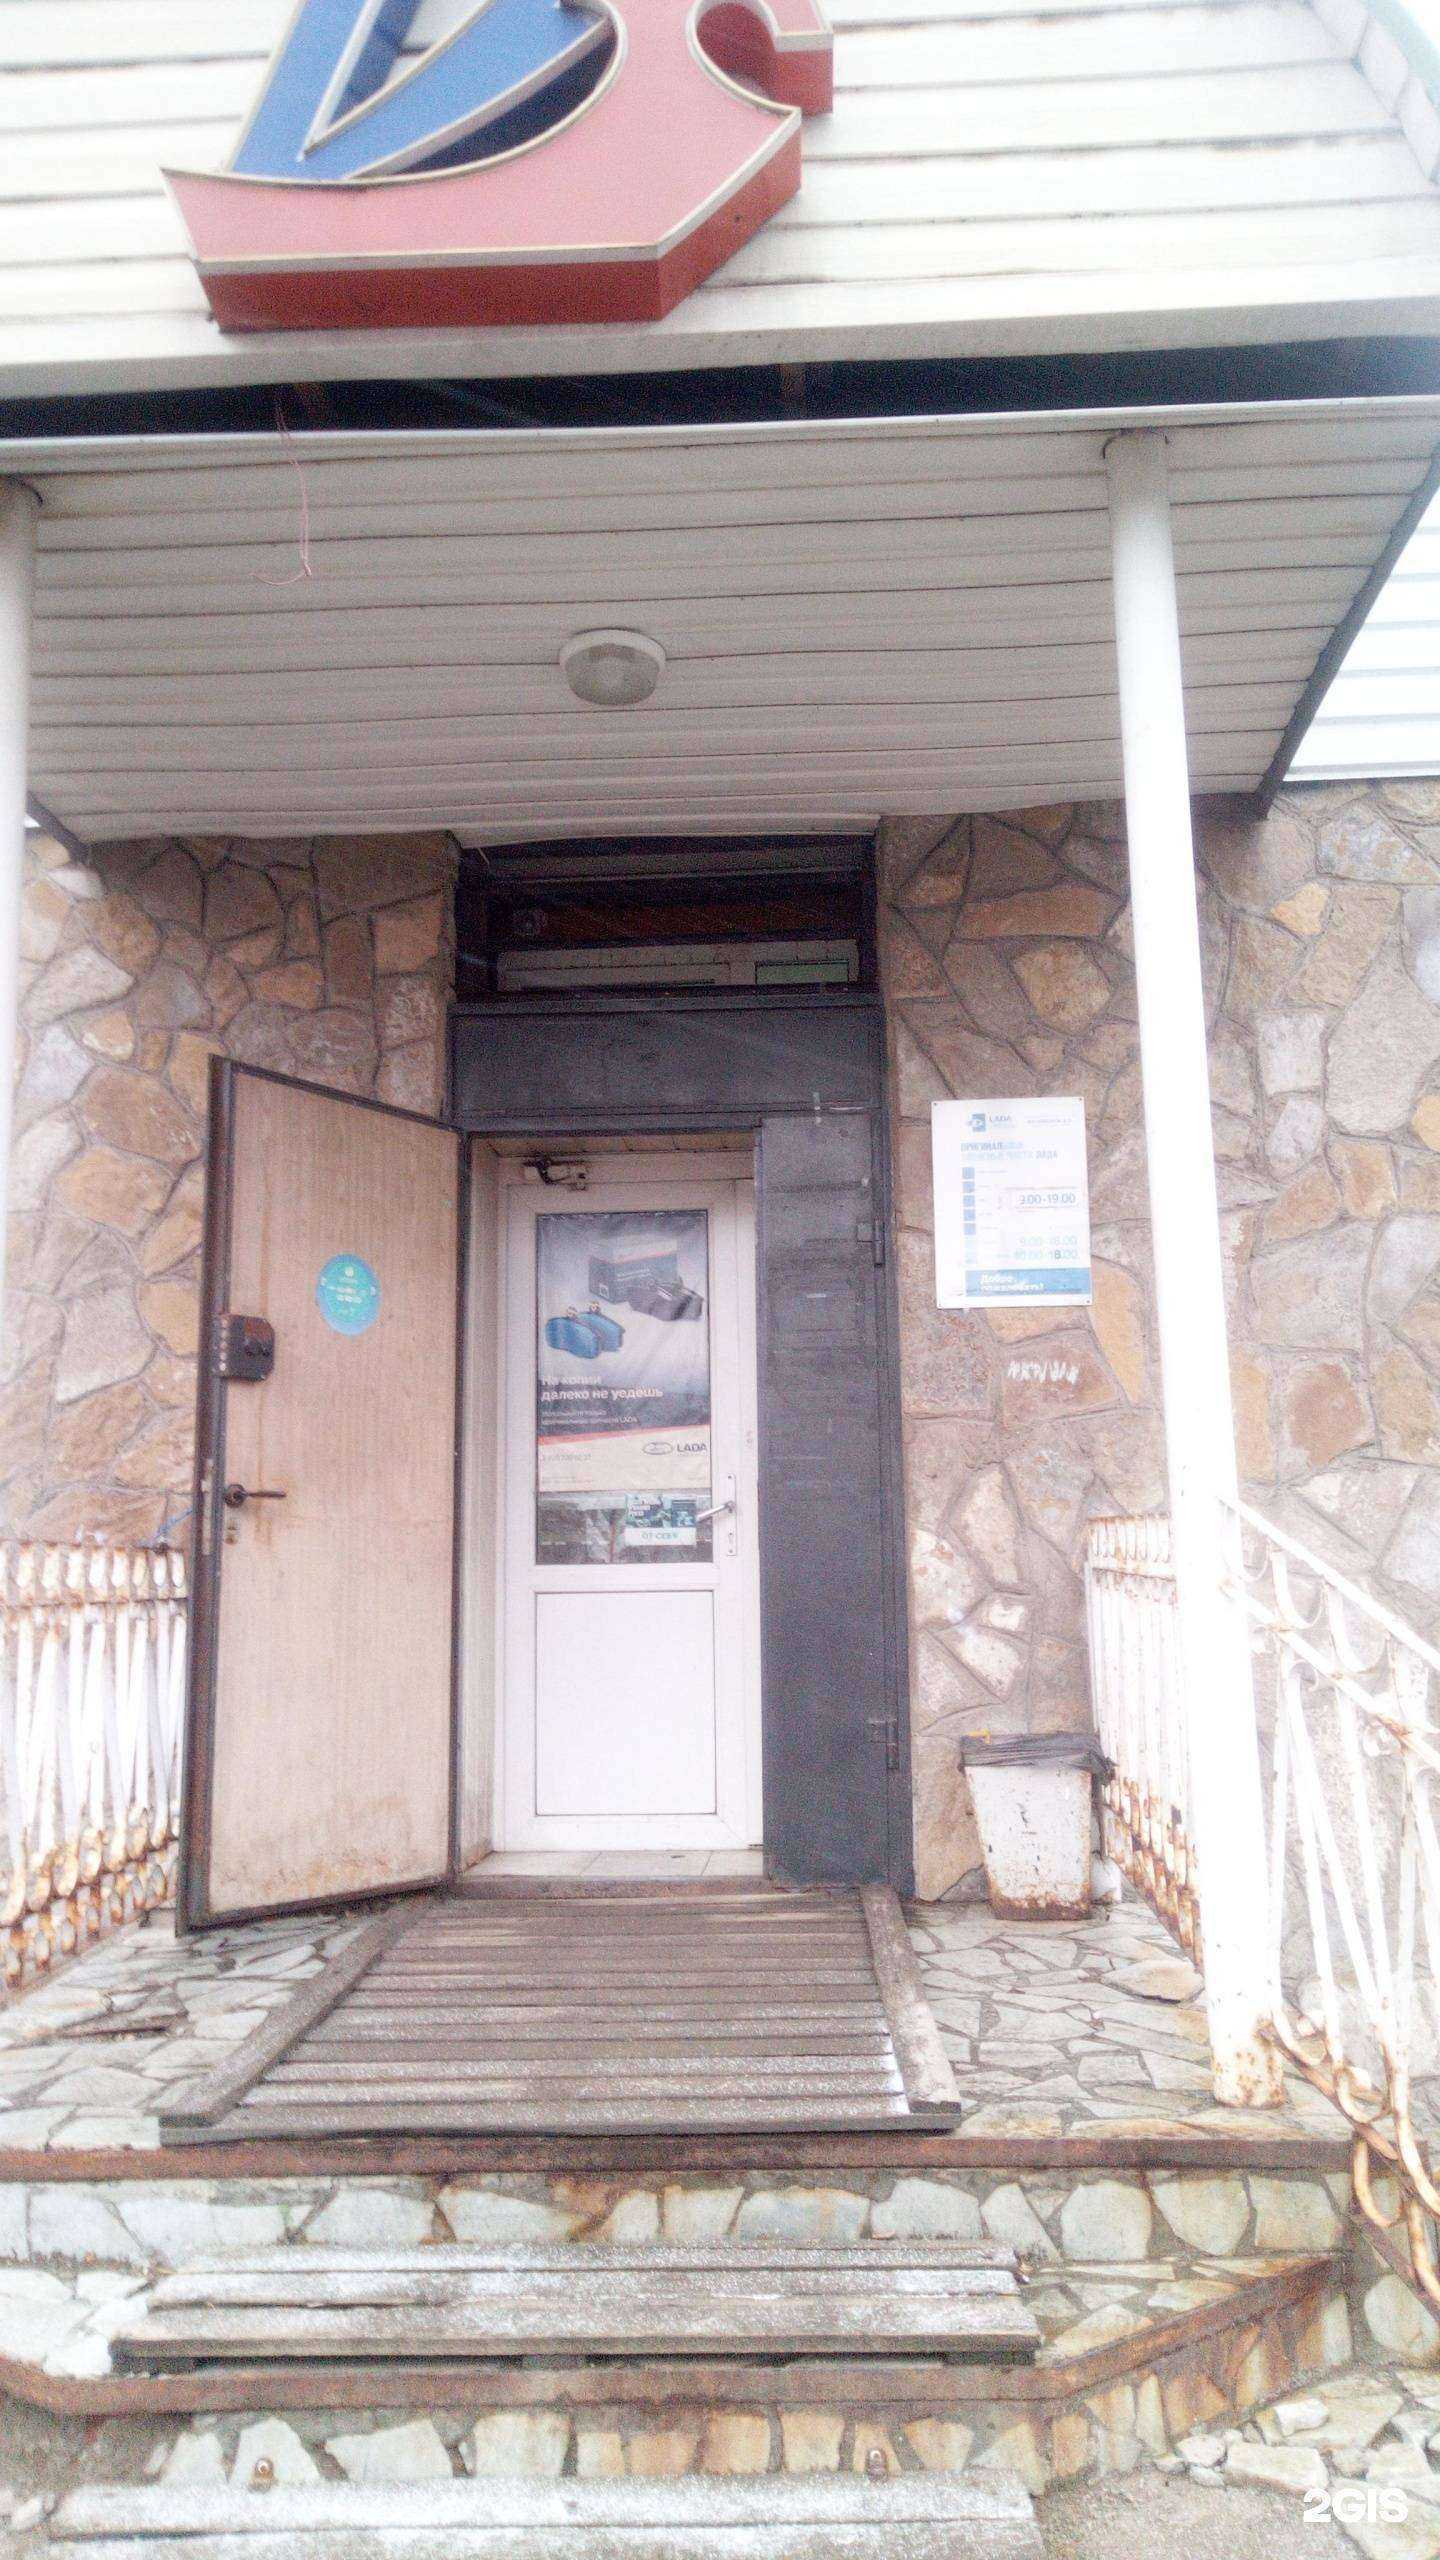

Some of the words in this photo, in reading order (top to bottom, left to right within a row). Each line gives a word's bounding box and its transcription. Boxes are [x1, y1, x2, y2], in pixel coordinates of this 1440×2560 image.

[541, 1389, 590, 1402] далеко
[592, 1389, 608, 1399] не
[676, 1442, 708, 1453] LADA
